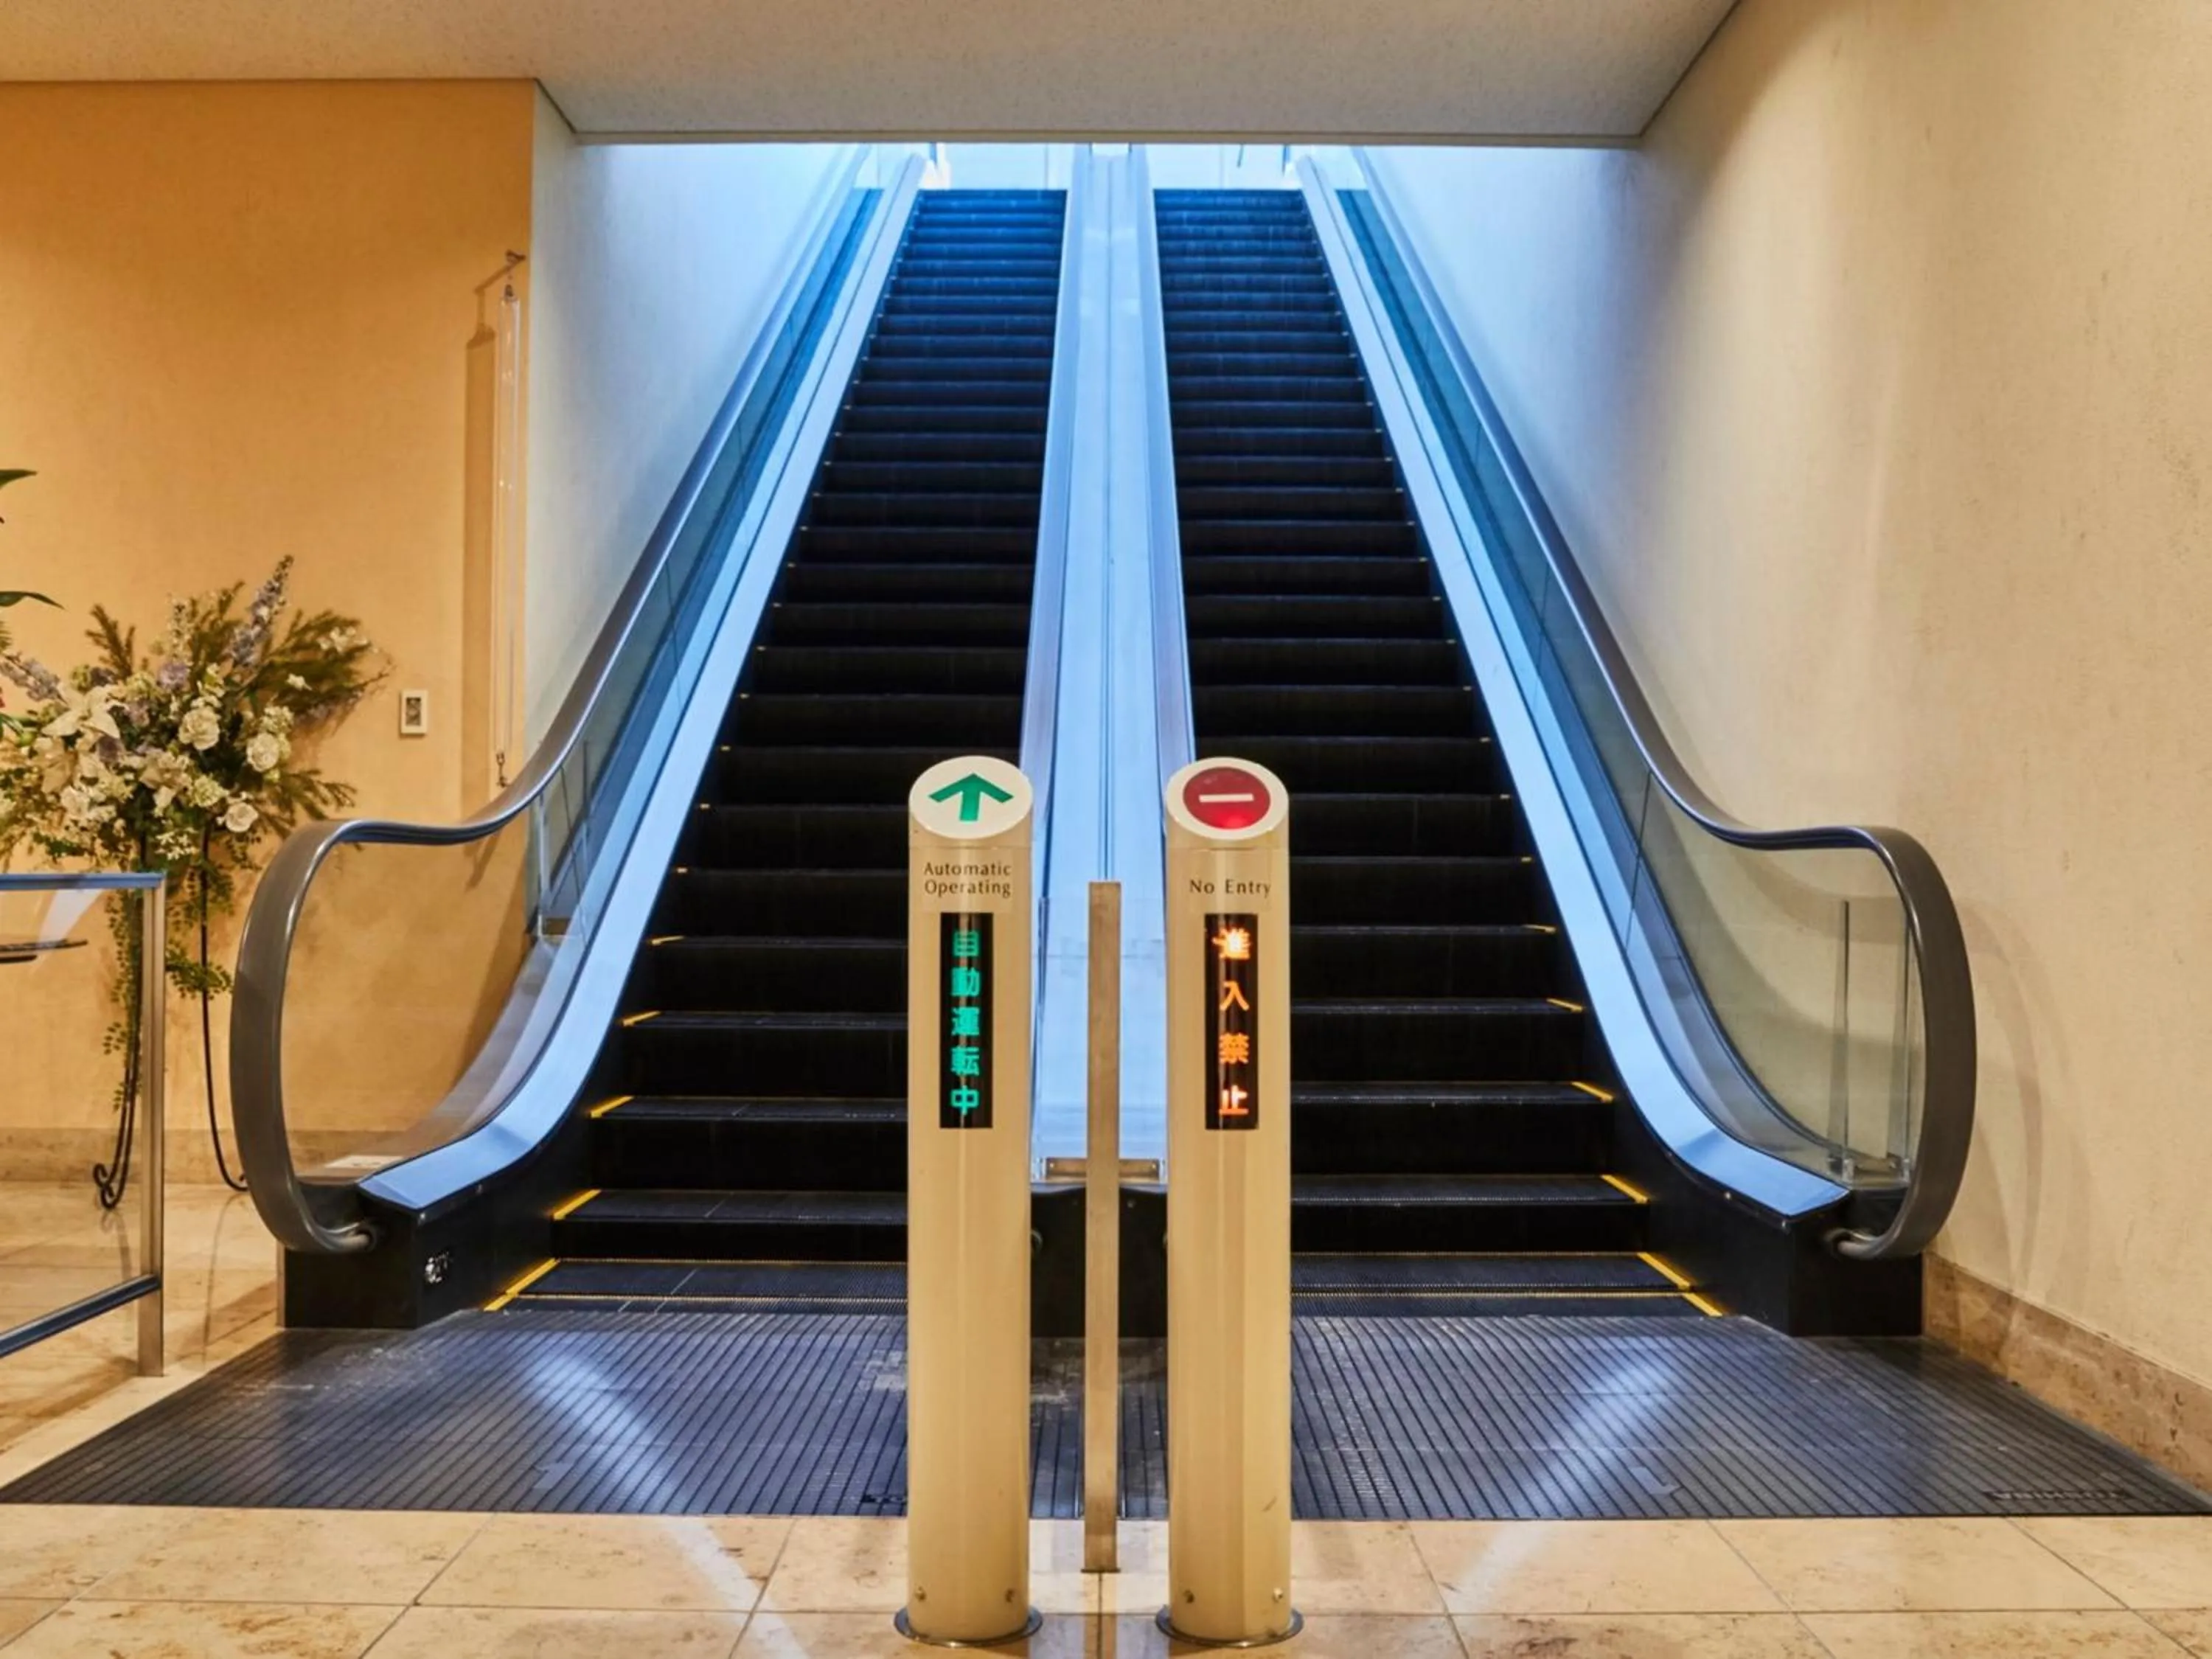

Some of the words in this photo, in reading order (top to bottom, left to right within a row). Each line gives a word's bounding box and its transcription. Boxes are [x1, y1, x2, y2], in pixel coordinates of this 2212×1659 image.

[924, 861, 1012, 876] Automatic
[924, 880, 1012, 899] Operating
[1189, 880, 1215, 894] No
[1225, 879, 1271, 899] Entry
[950, 929, 981, 1116] 自動運転中
[1212, 927, 1251, 1116] 進入禁止
